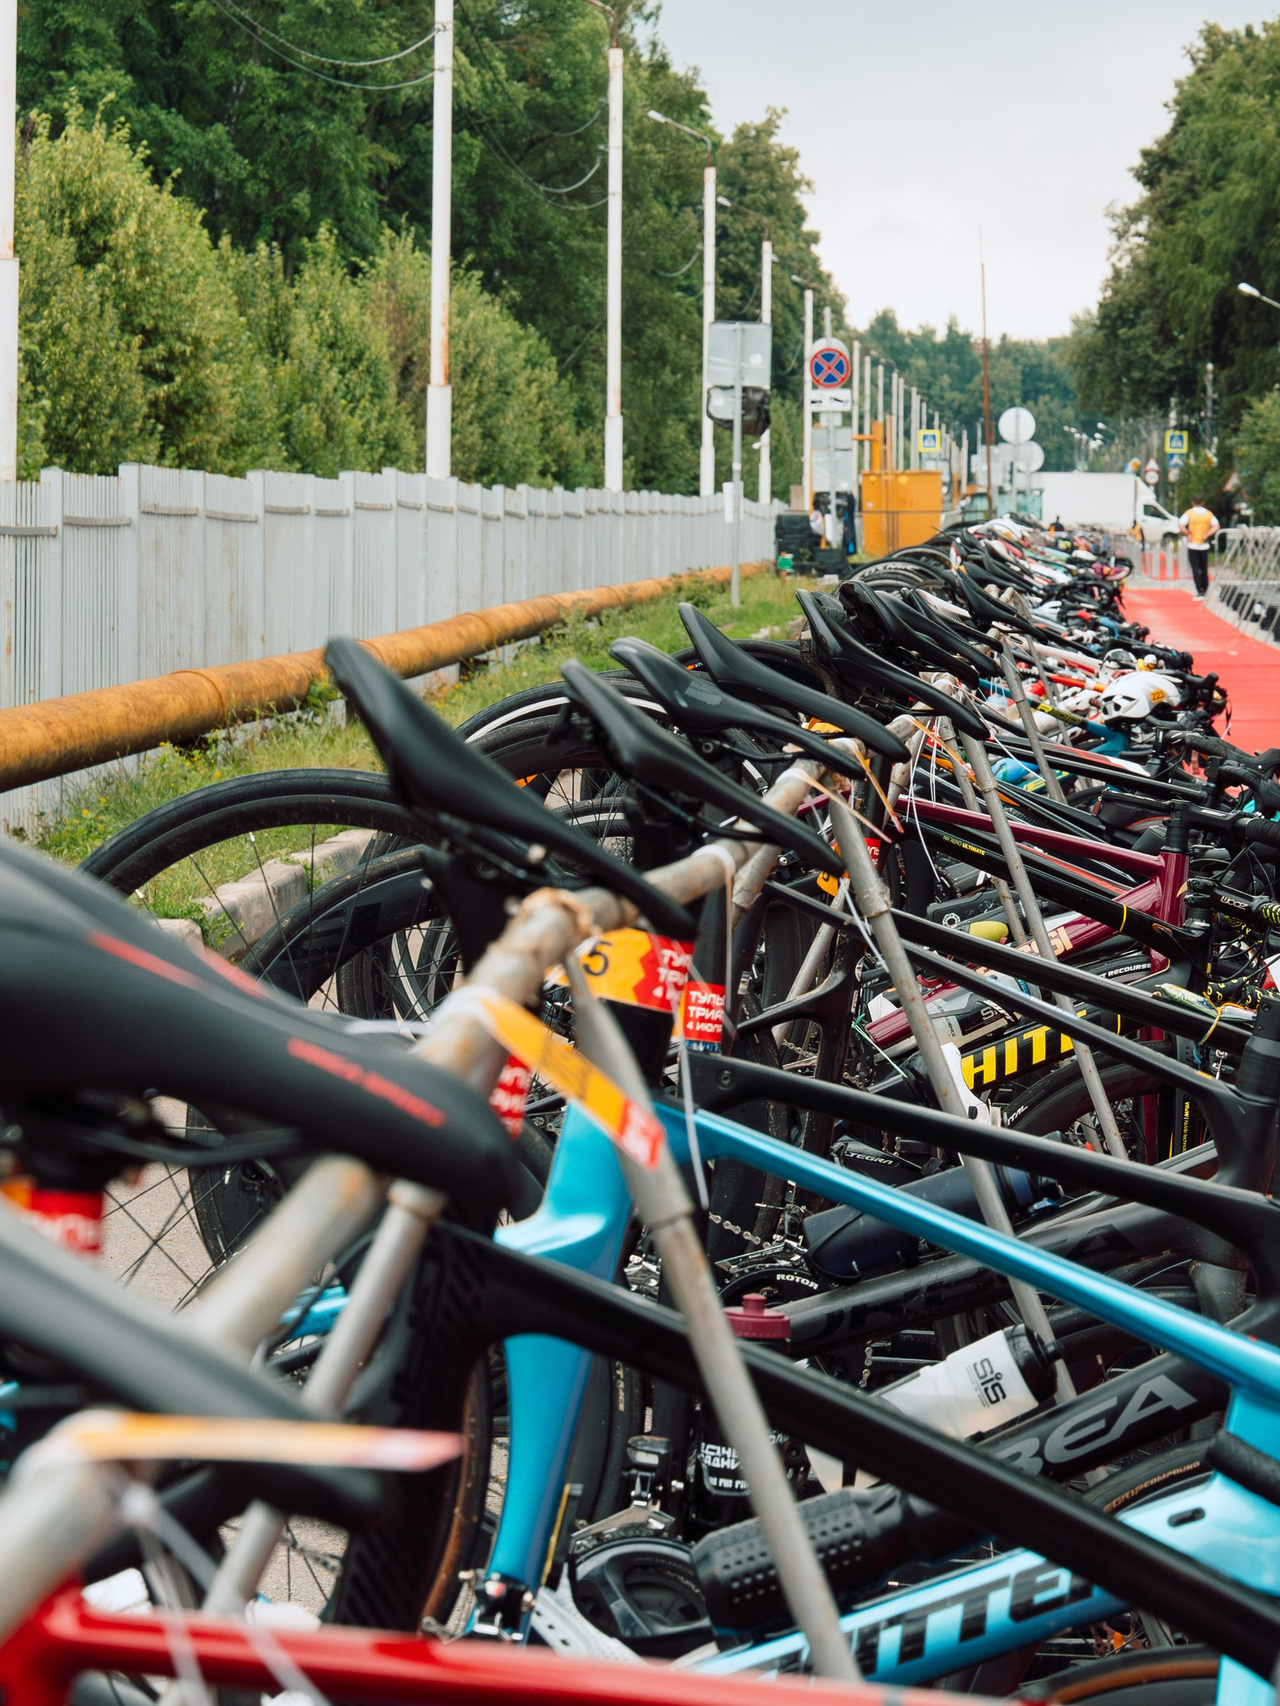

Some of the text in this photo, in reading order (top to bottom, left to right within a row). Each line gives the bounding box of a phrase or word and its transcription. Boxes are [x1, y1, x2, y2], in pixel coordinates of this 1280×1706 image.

[1151, 690, 1165, 701] 223
[1108, 963, 1151, 977] RECOURSE
[776, 1273, 819, 1290] ROTOR
